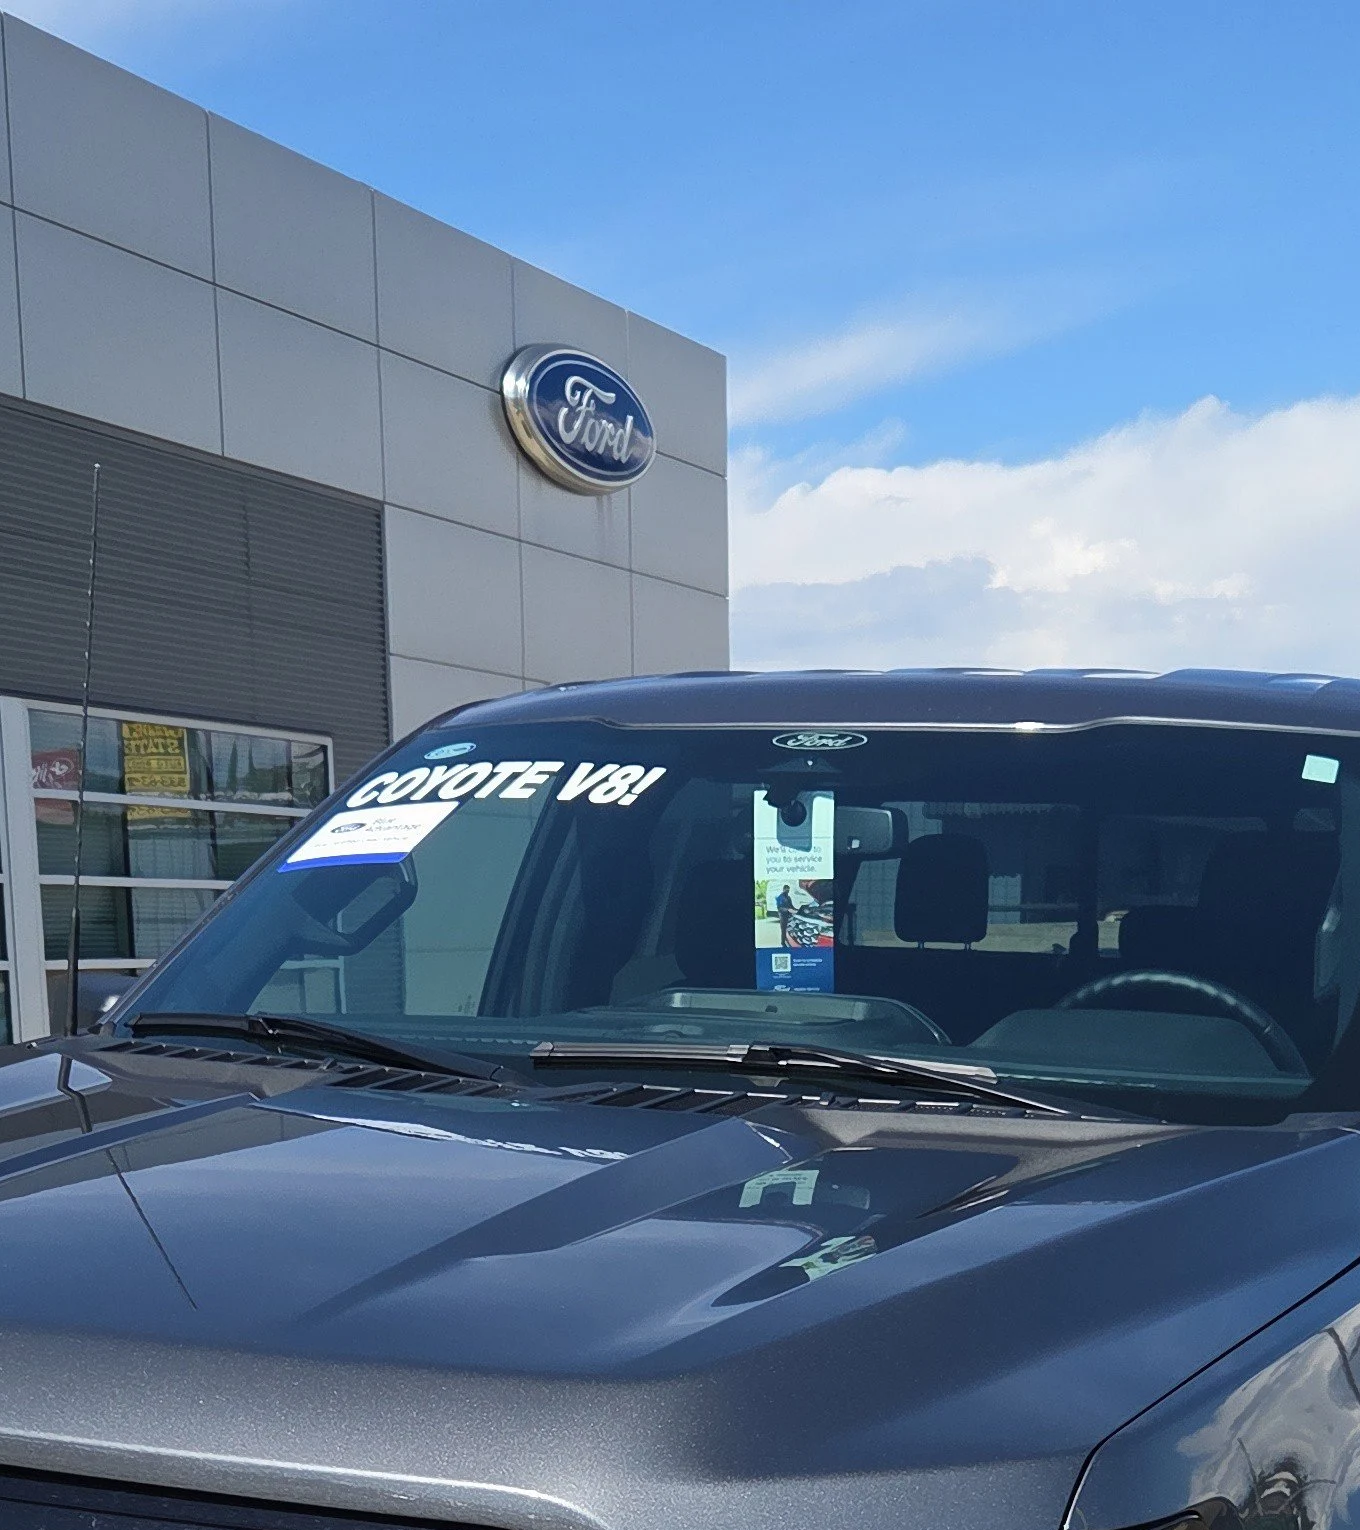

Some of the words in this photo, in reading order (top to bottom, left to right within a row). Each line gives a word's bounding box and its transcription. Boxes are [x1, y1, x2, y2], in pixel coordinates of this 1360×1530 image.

[557, 375, 634, 464] Ford
[786, 733, 853, 747] Ford
[346, 761, 565, 808] COYOTE
[556, 761, 667, 806] V8!
